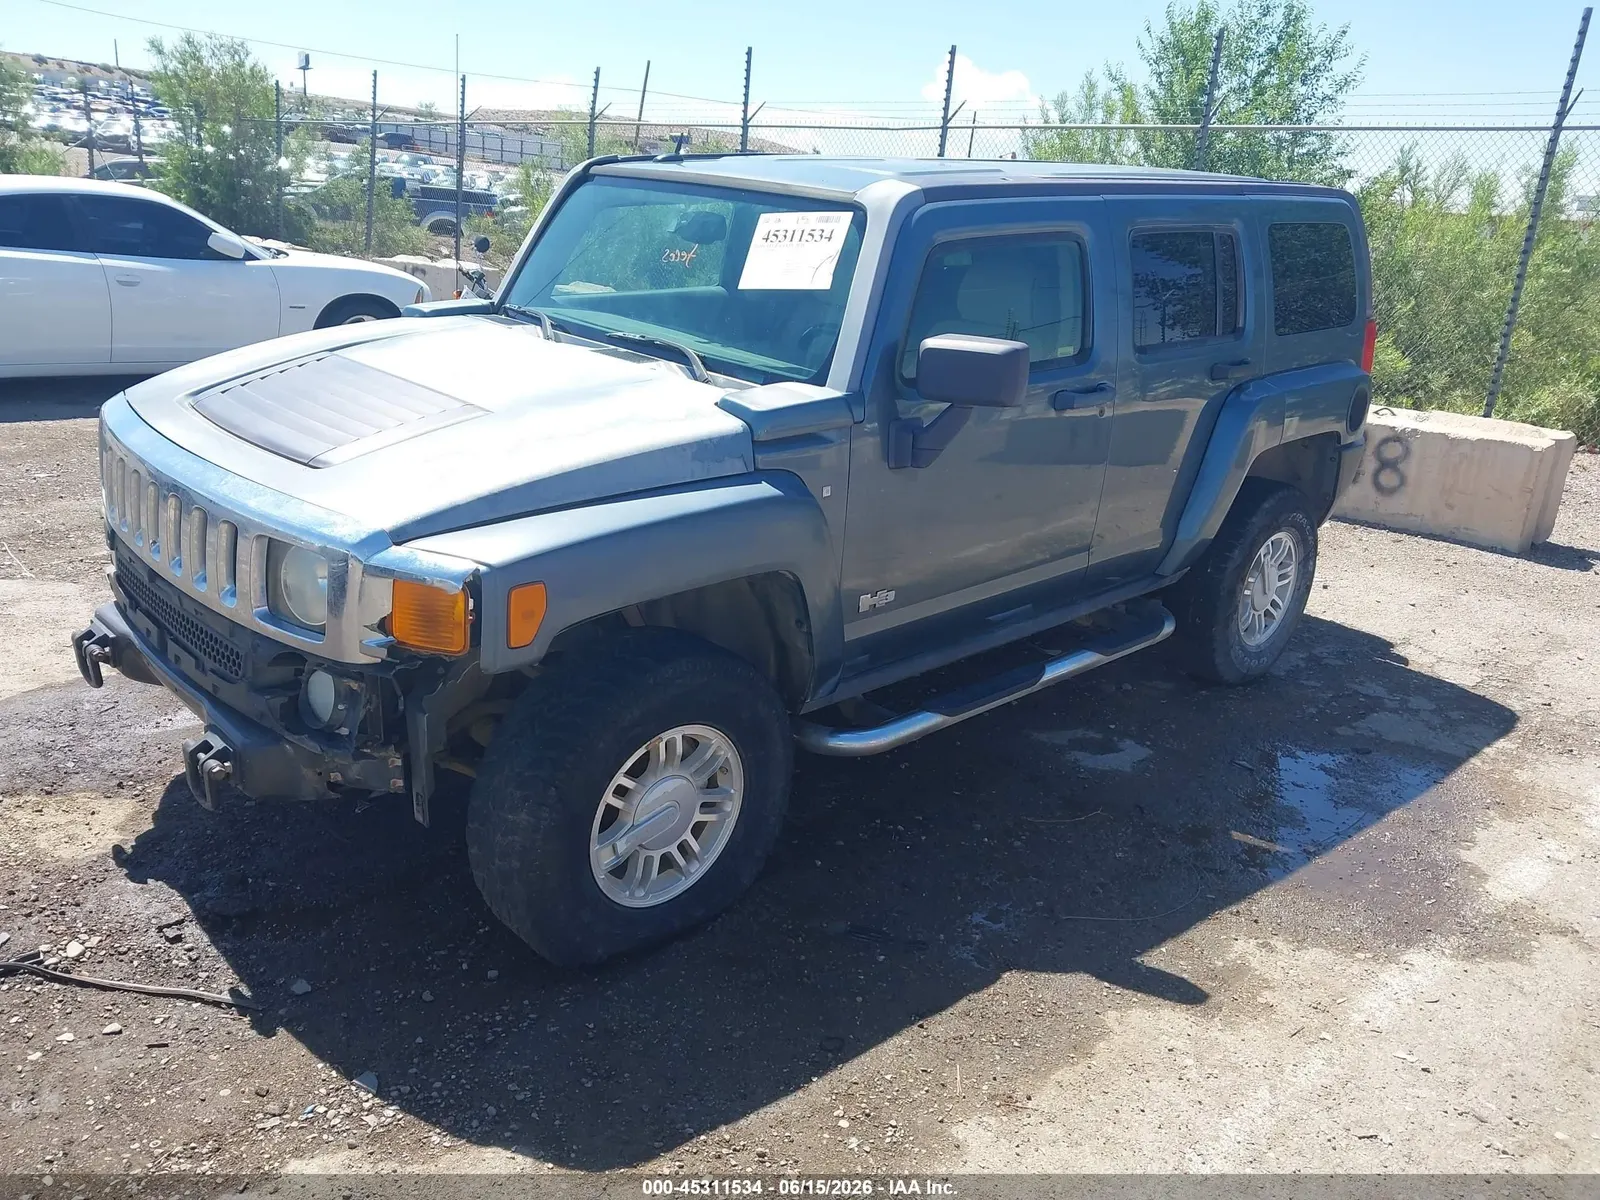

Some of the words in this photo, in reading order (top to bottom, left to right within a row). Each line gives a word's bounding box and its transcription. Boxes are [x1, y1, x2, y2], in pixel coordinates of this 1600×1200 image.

[761, 228, 835, 243] 45311534
[1372, 436, 1411, 496] 8
[859, 589, 895, 612] H3
